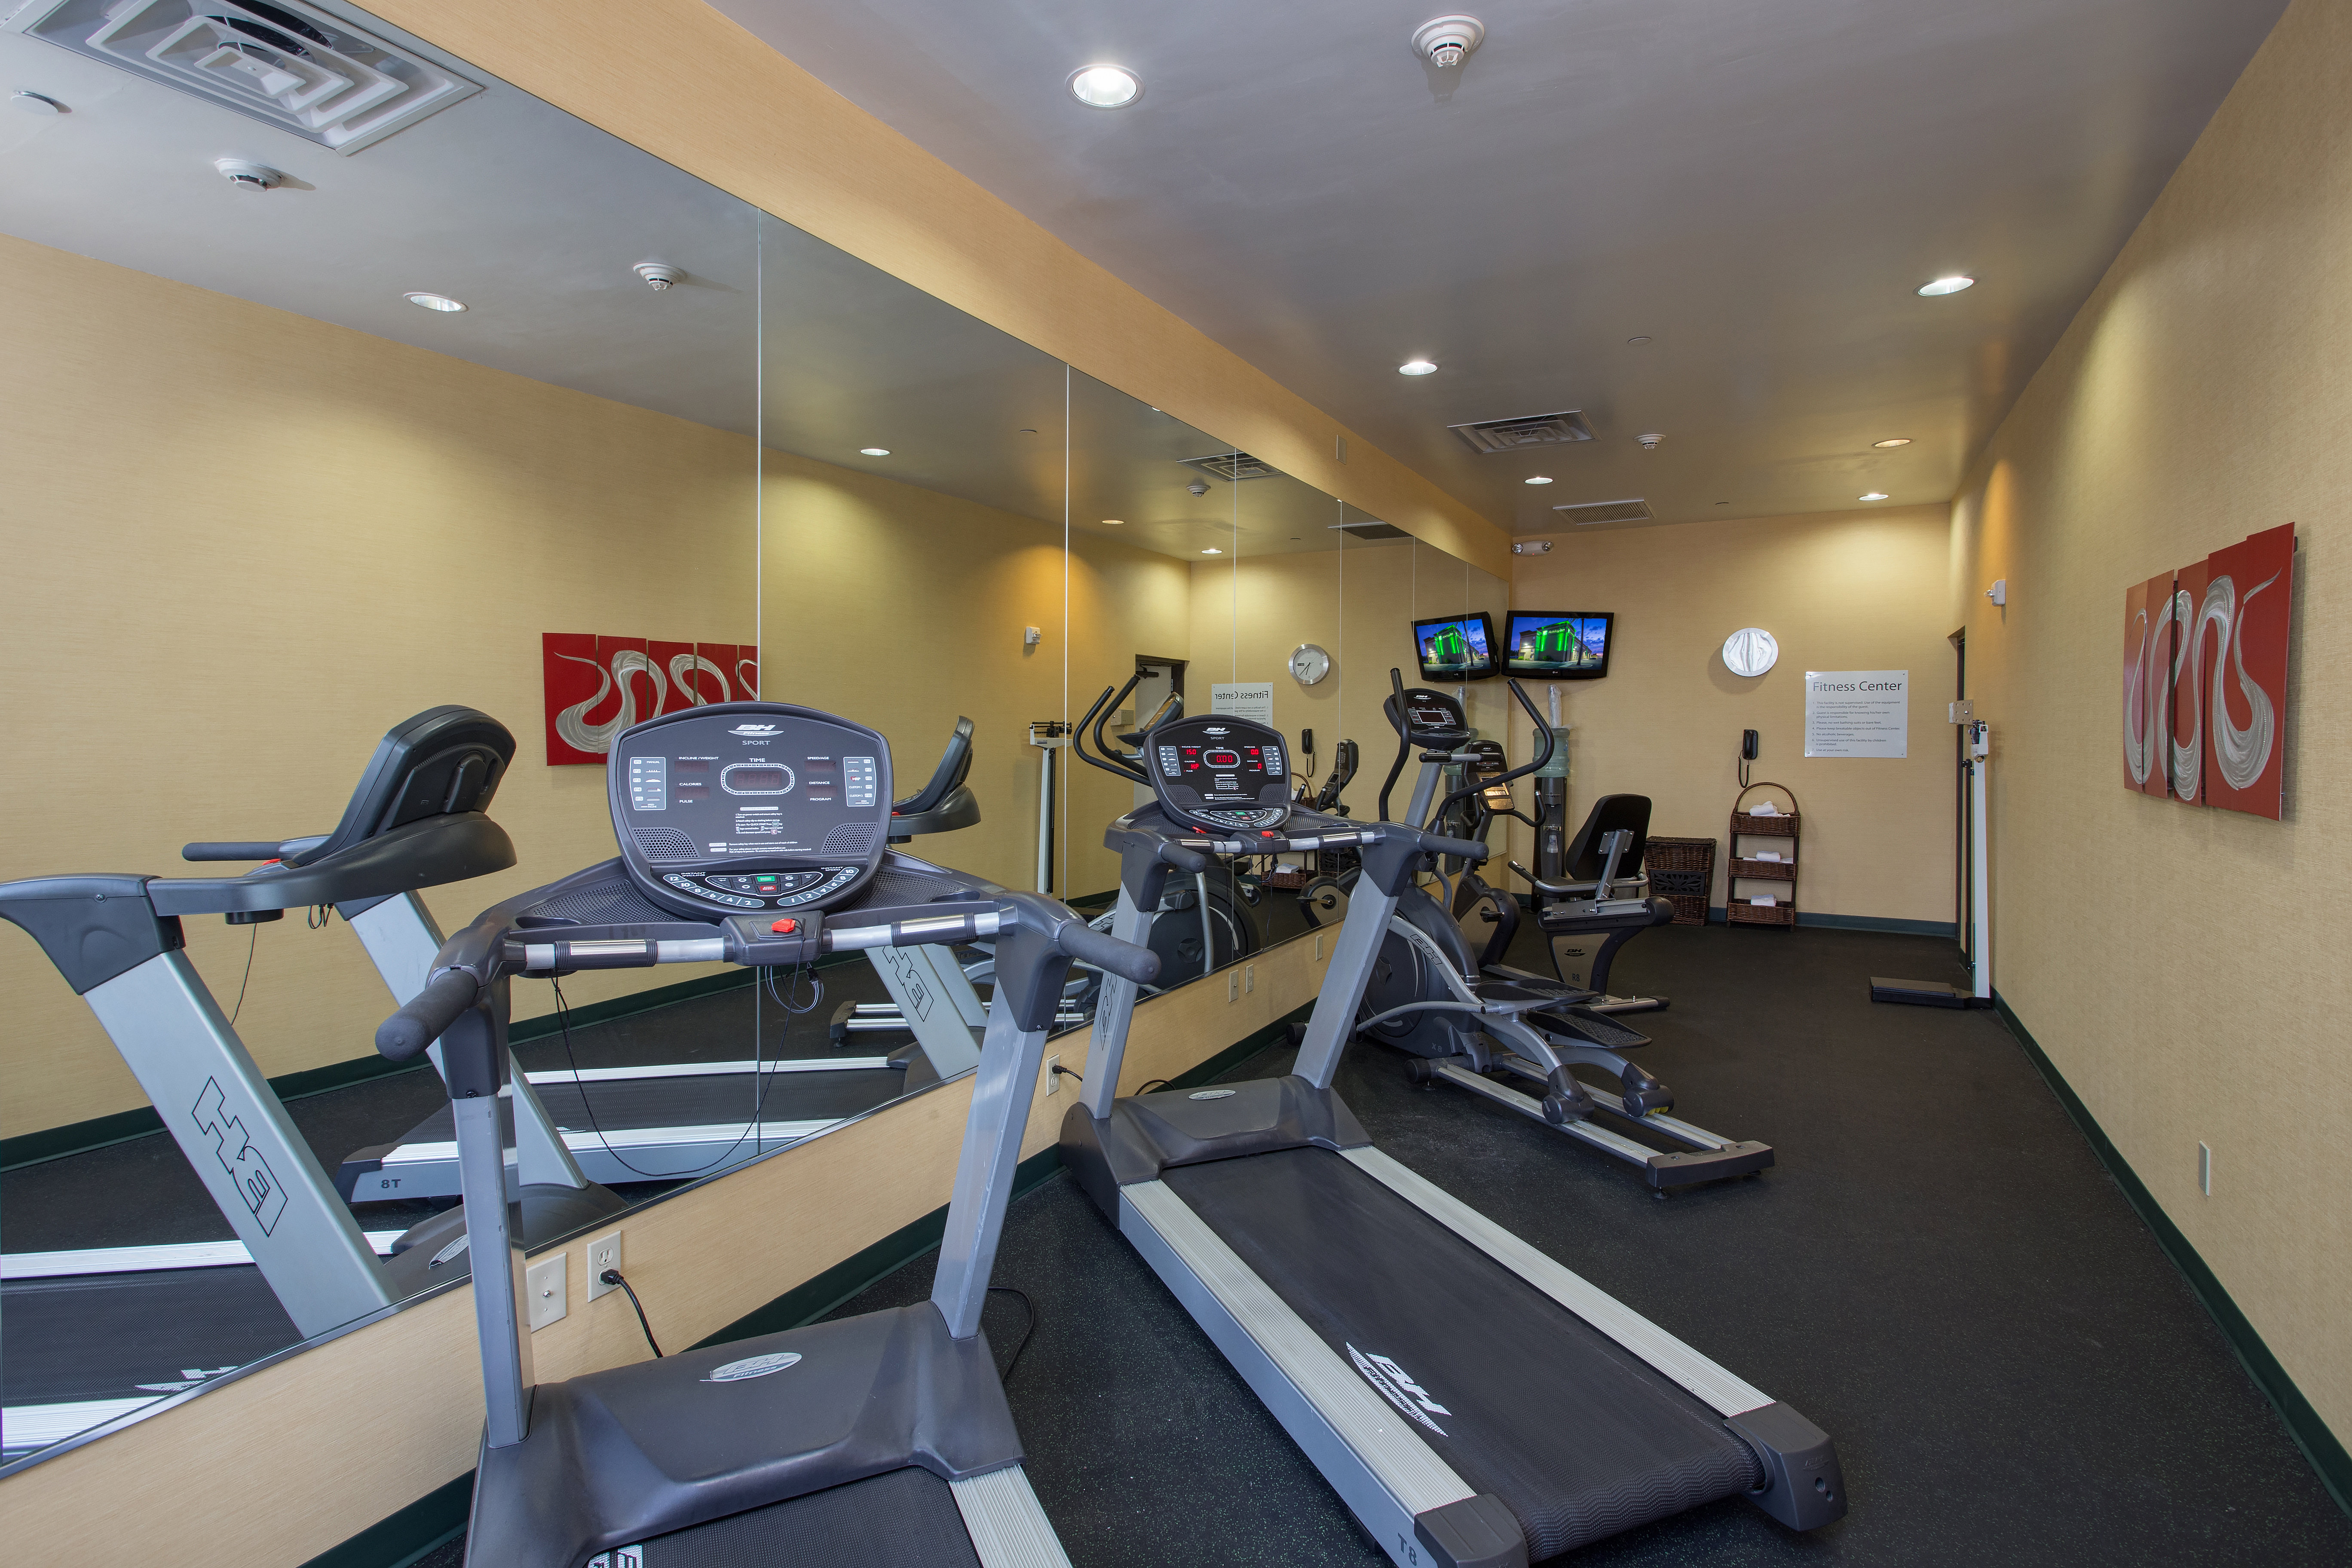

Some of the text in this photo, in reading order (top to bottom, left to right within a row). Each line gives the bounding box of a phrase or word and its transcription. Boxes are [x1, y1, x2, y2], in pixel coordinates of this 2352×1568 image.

[1813, 681, 1902, 692] Fitness Center
[1410, 934, 1443, 965] BH
[1572, 973, 1580, 982] R8
[1431, 1042, 1442, 1053] X8
[722, 1354, 784, 1375] BH
[732, 1365, 778, 1378] Fitness
[1365, 1353, 1452, 1416] BH
[1397, 1532, 1417, 1566] T8
